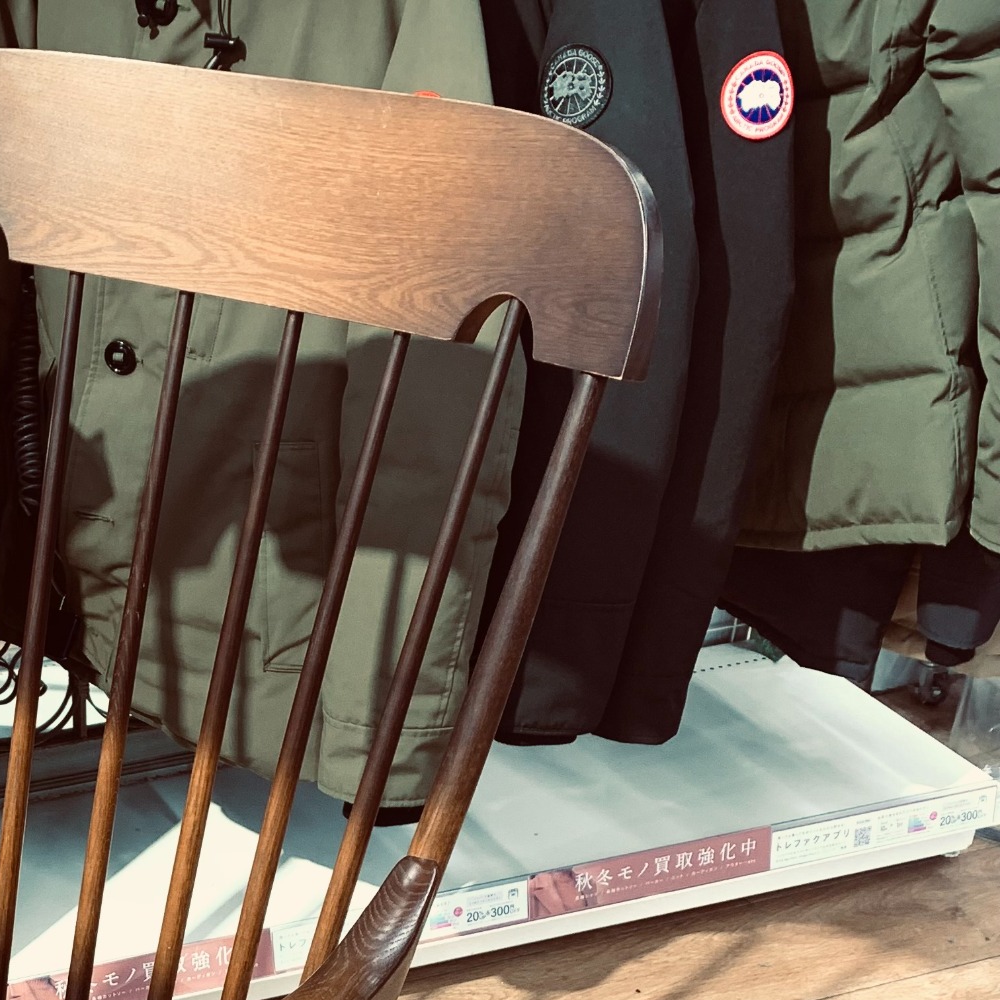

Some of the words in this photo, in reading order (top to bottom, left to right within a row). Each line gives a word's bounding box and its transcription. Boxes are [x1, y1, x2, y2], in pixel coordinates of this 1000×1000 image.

[578, 49, 600, 68] GOOSE
[776, 830, 850, 852] トレファクアプリ
[575, 838, 757, 892] 秋冬モノ買取強化中
